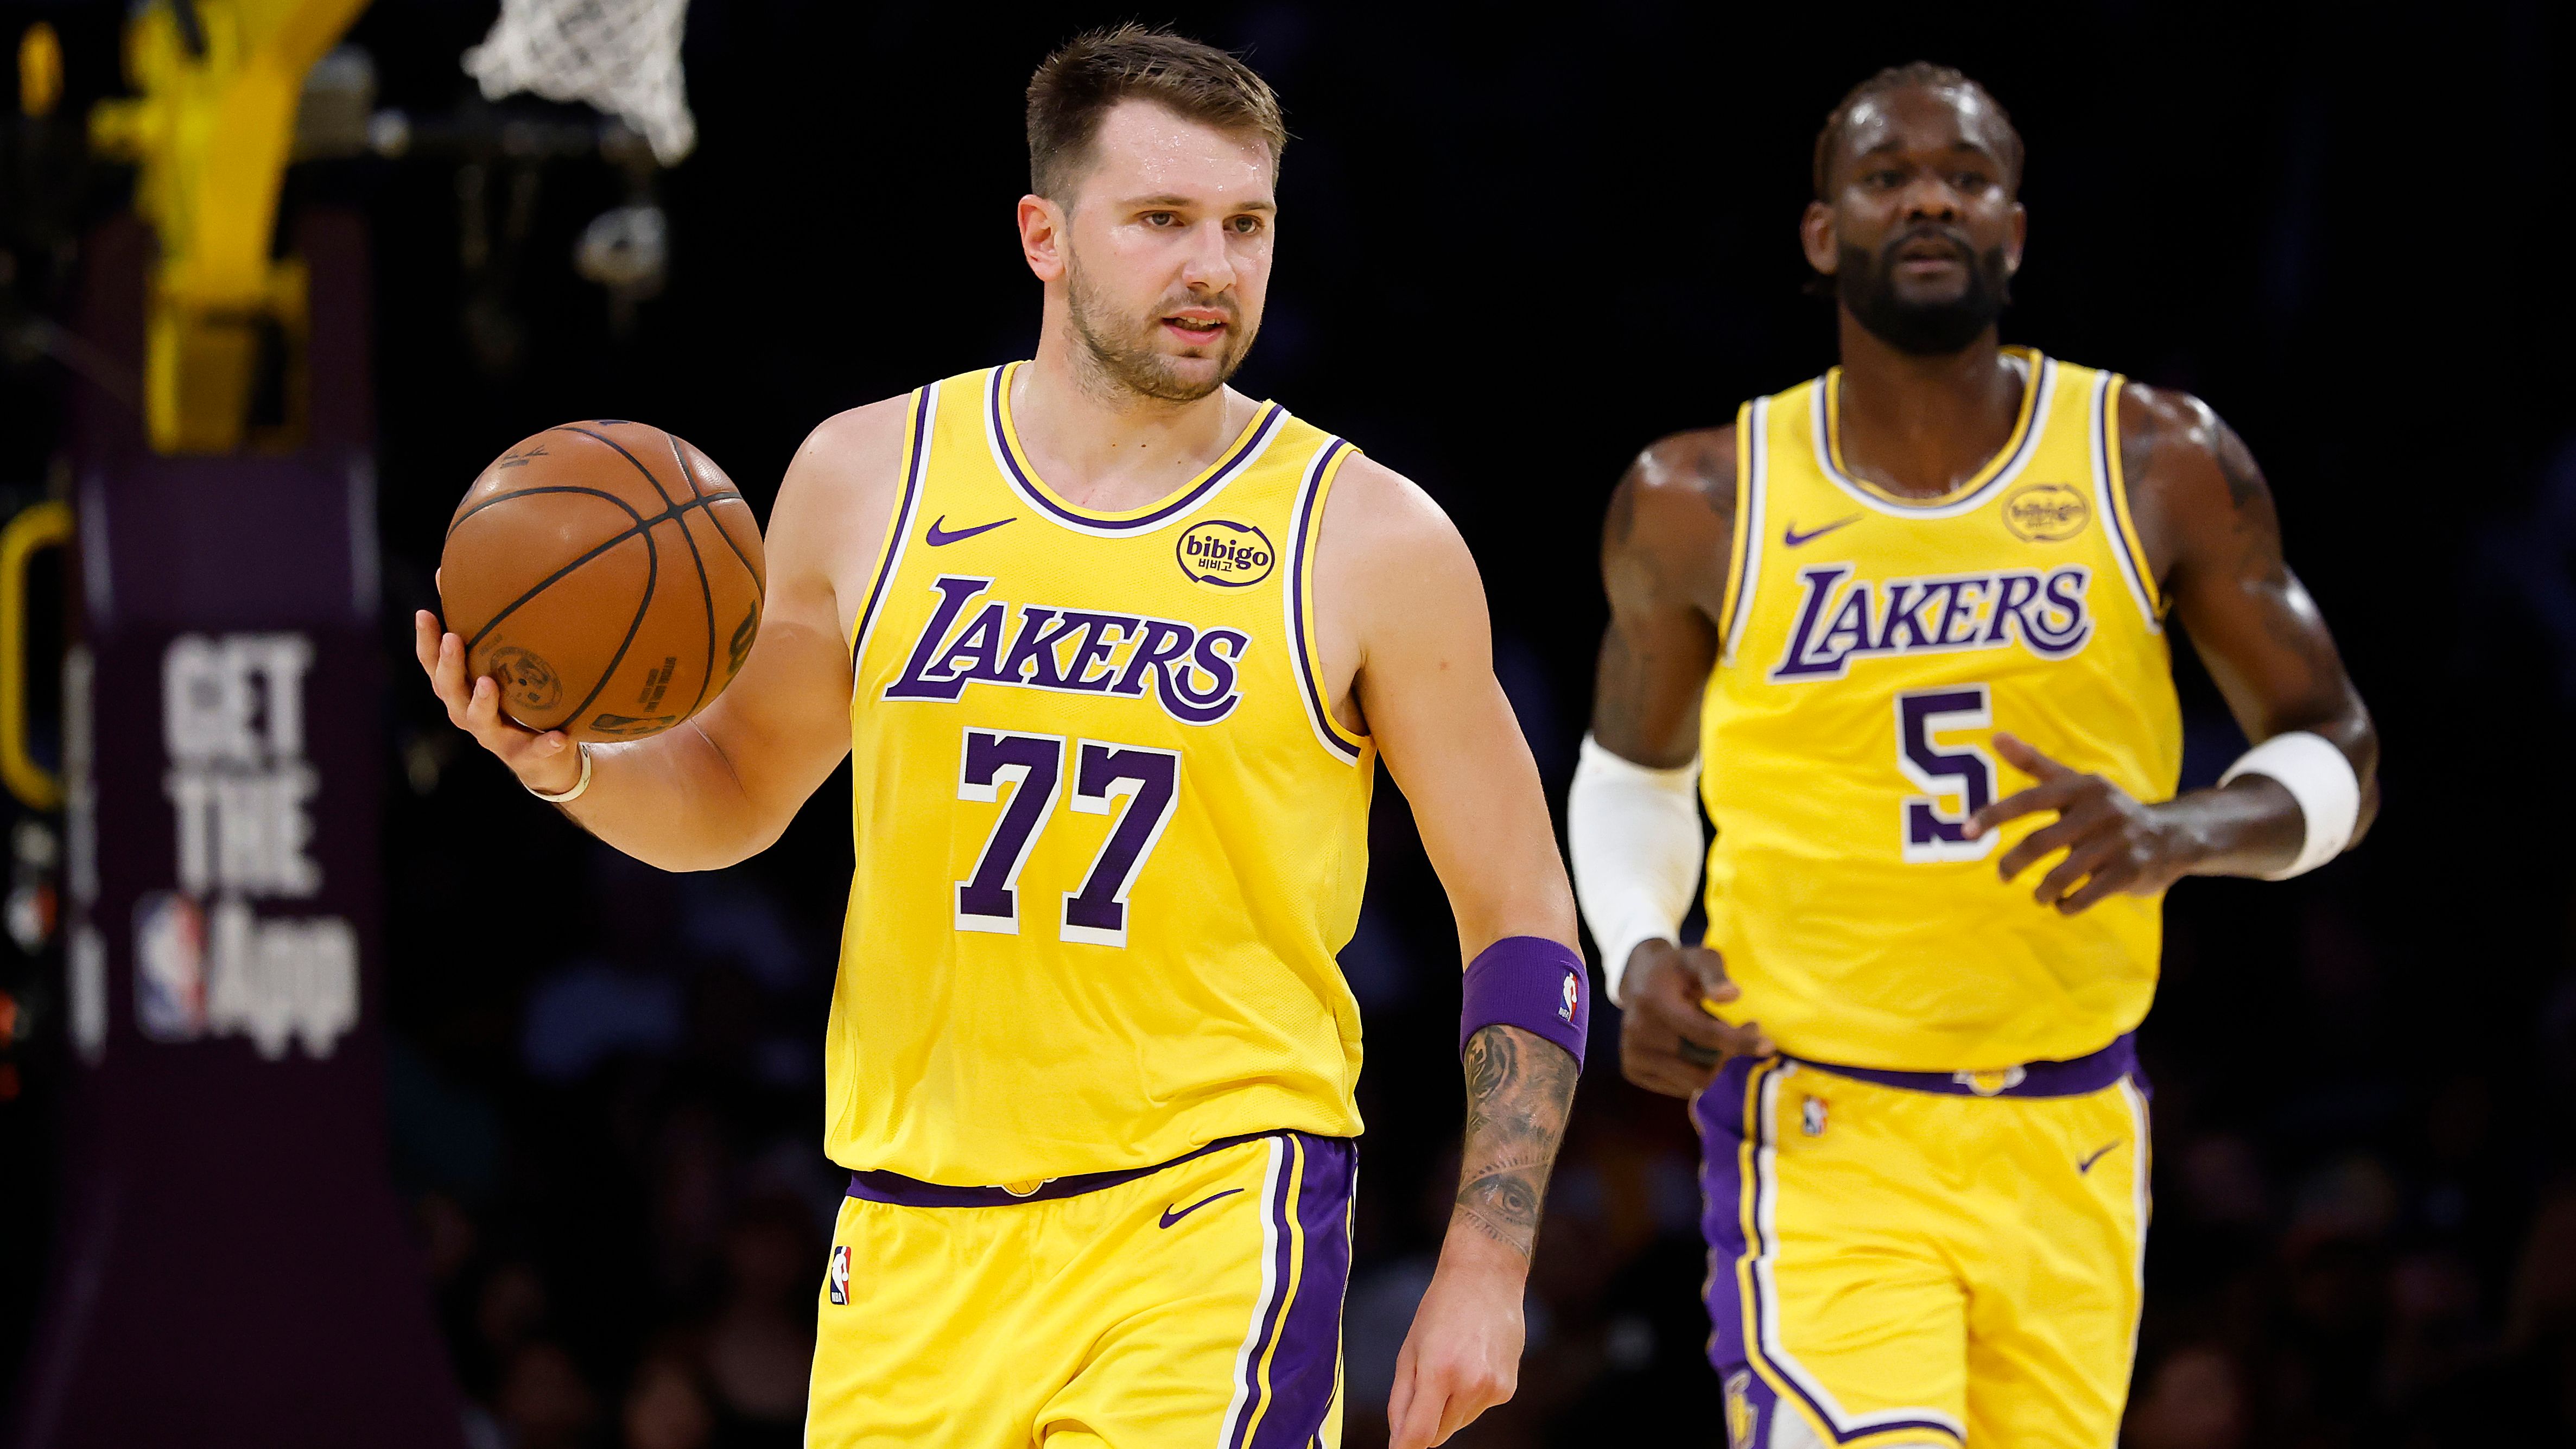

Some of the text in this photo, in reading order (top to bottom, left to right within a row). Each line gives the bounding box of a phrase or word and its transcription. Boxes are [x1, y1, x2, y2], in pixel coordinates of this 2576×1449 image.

[1187, 535, 1268, 570] bibigo
[1198, 558, 1232, 572] 비비고
[882, 574, 1253, 726] LAKERS
[1766, 561, 2092, 684] LAKERS
[162, 633, 316, 759] GET
[163, 761, 322, 899] THE
[1895, 684, 2000, 863] 5
[955, 726, 1182, 949] 77
[208, 898, 360, 1060] App
[1558, 1007, 1570, 1020] NBA
[832, 1292, 842, 1302] NBA
